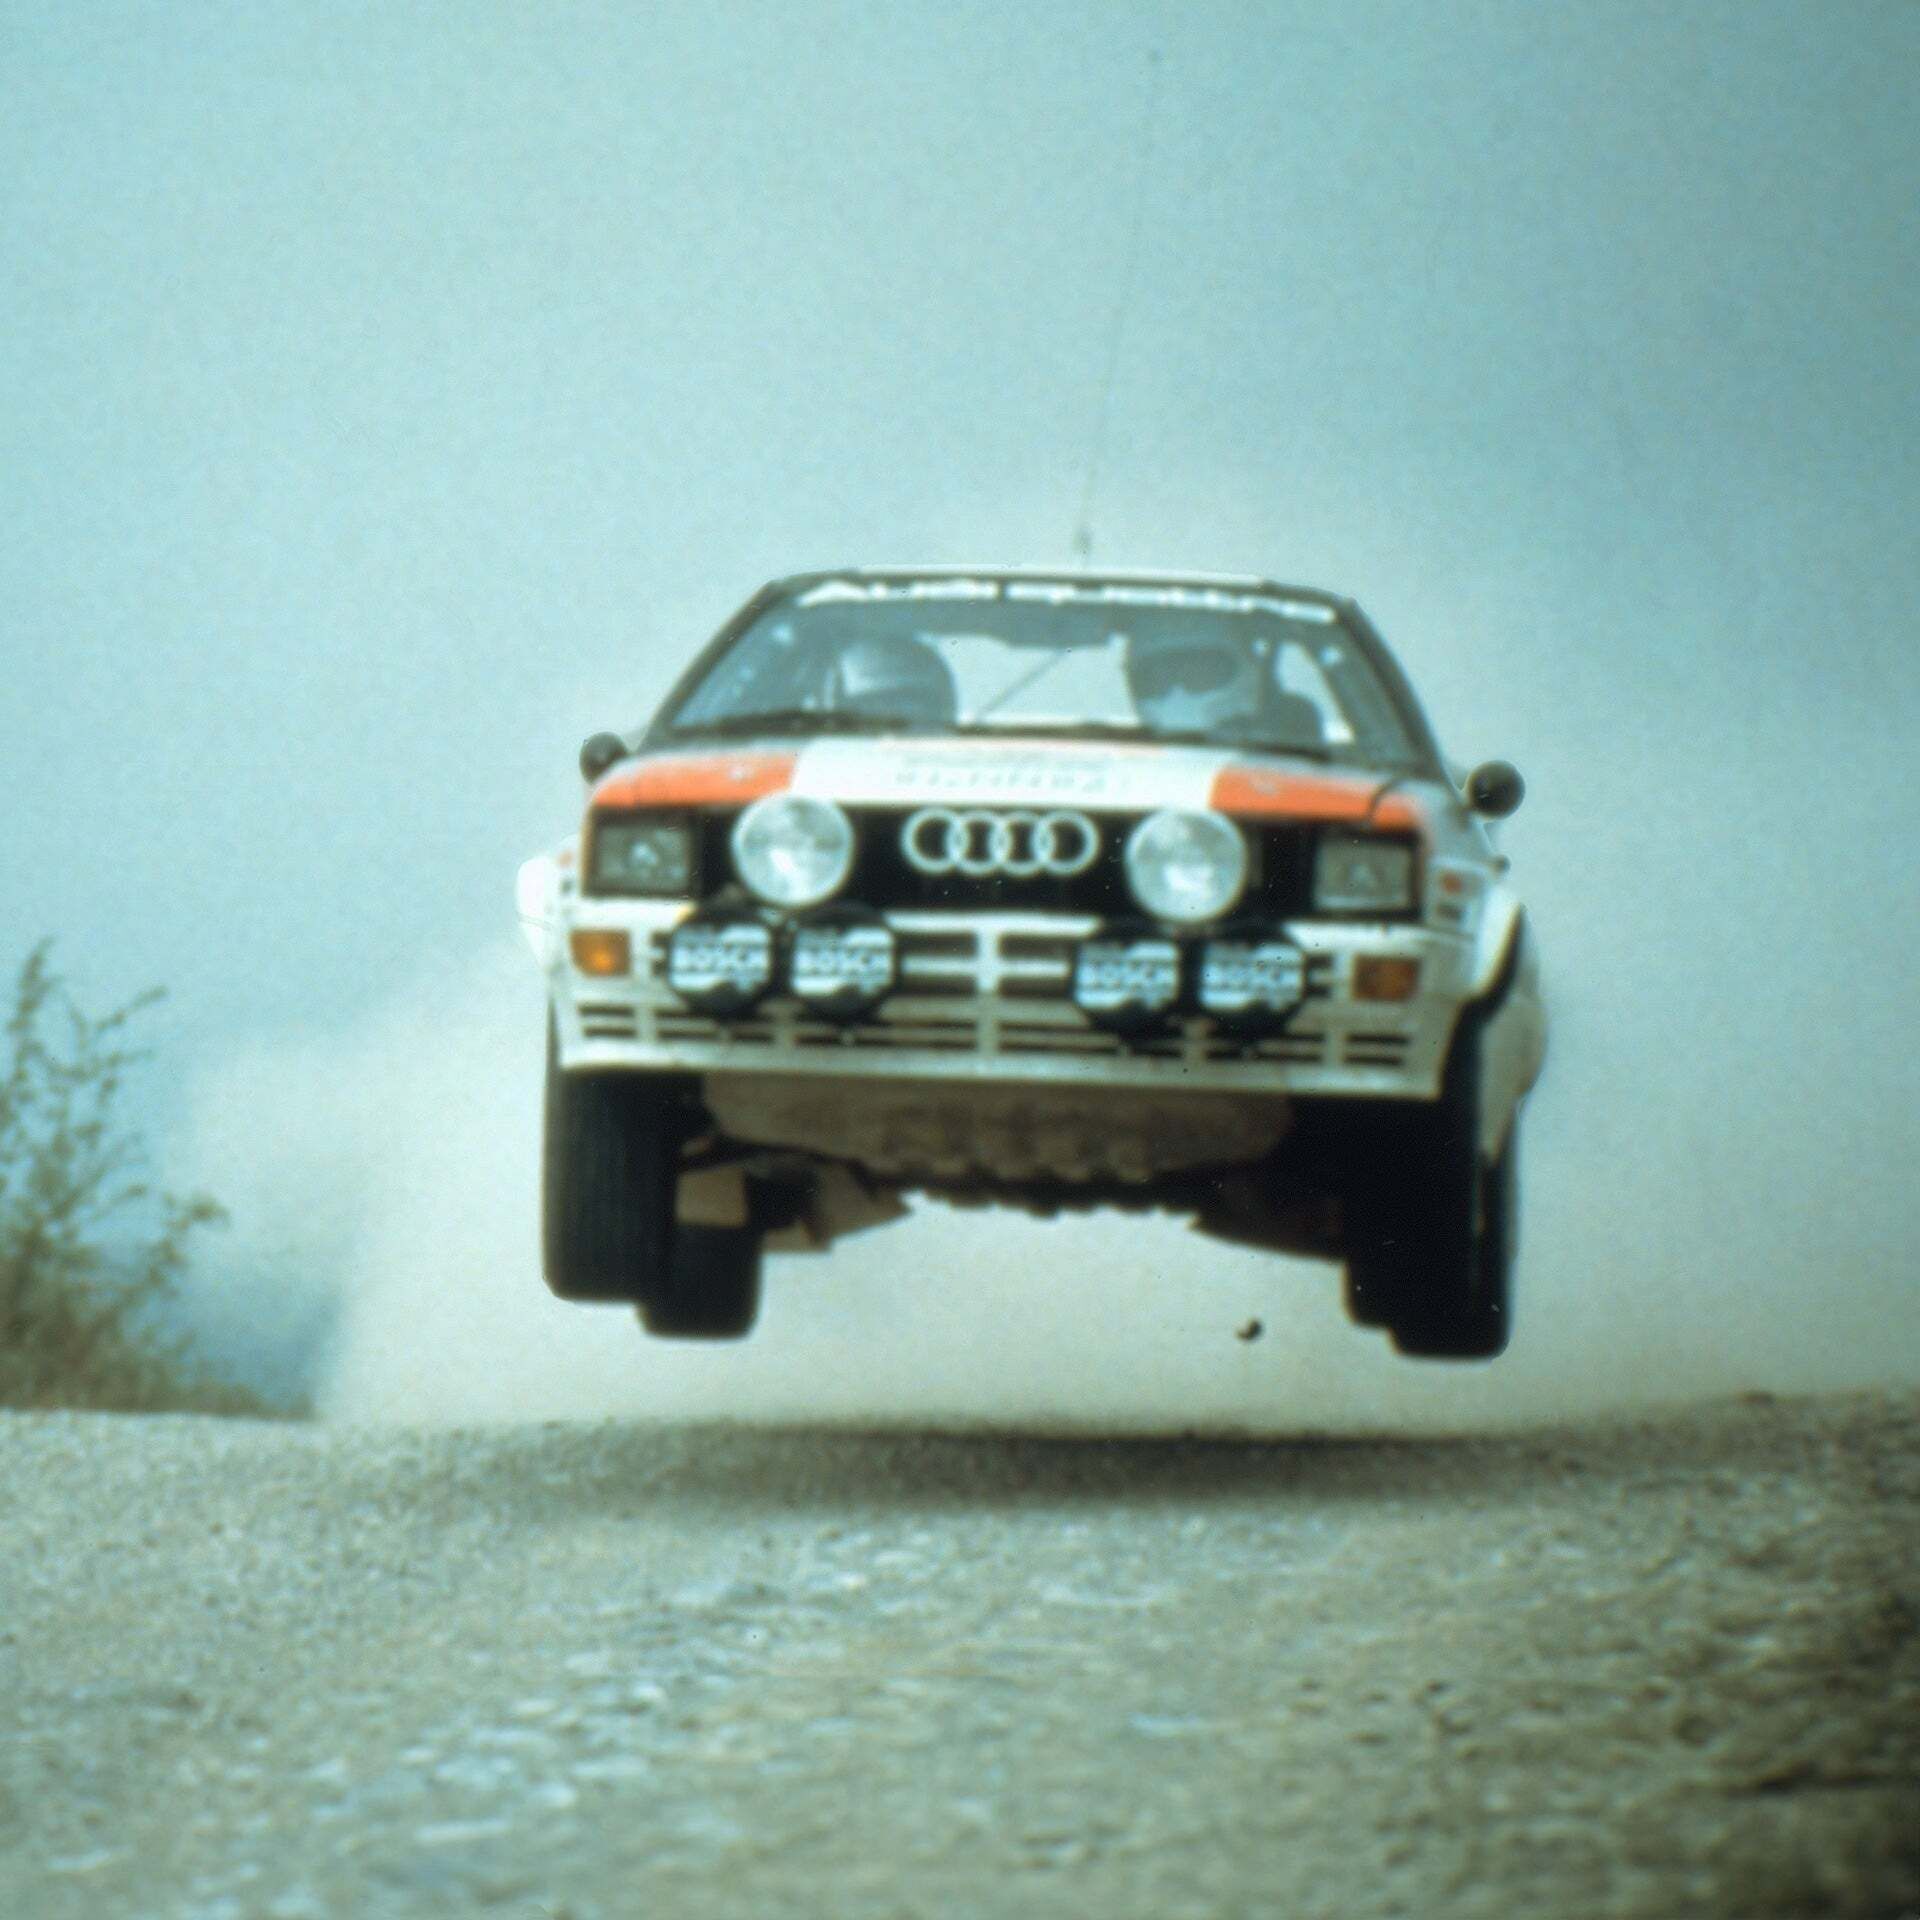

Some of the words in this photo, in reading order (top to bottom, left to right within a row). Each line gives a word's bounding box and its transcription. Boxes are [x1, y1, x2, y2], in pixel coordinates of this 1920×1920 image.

[672, 946, 770, 973] BOSCH
[796, 949, 893, 976] BOSCH
[1080, 961, 1178, 989] BOSCH
[1204, 962, 1302, 990] BOSCH
